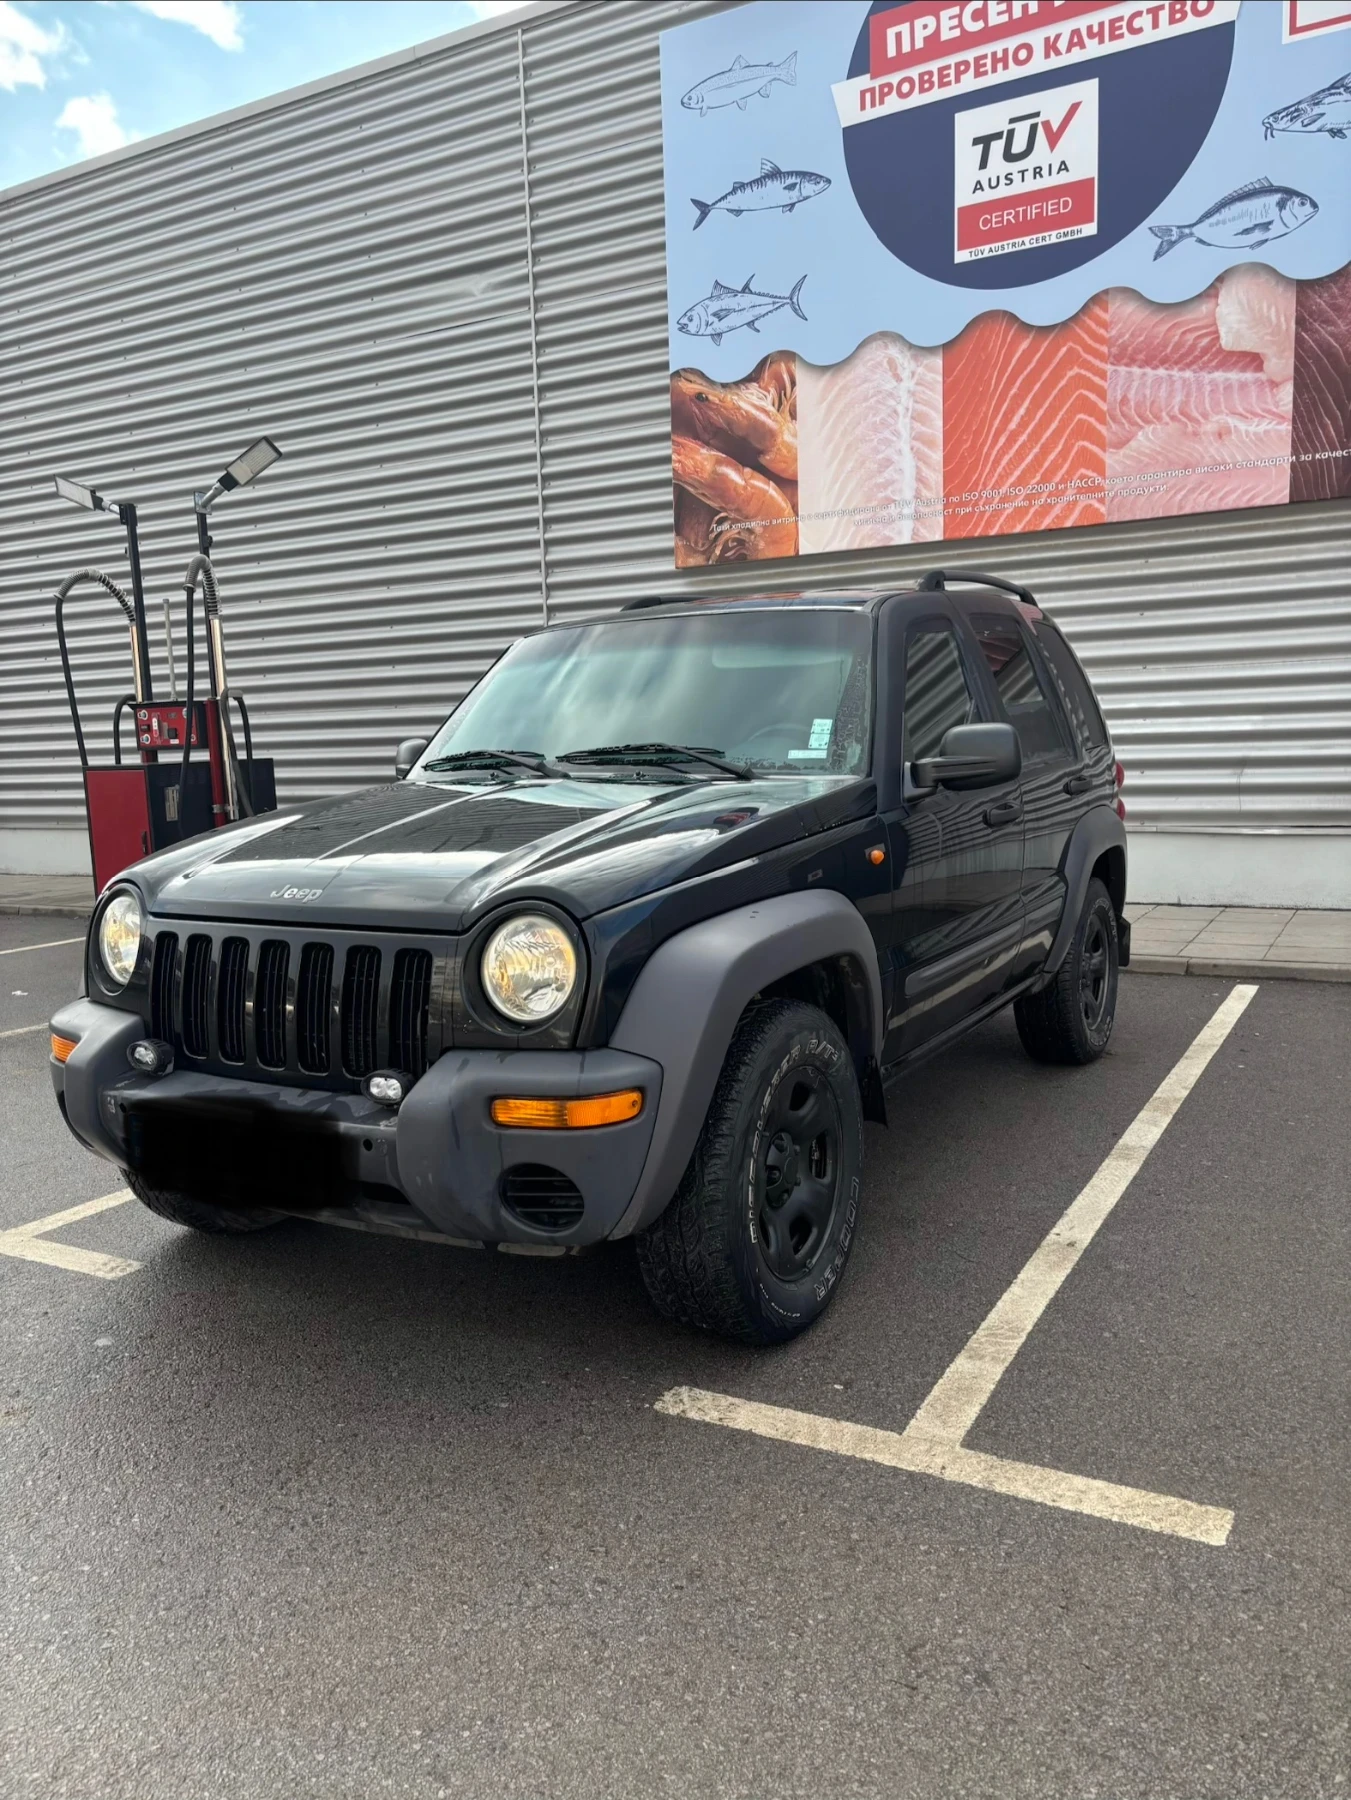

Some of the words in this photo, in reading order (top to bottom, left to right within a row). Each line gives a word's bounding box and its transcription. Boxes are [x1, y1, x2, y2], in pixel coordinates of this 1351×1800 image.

[886, 0, 1039, 58] ПРЕСЕН
[859, 42, 1034, 112] ПРОВЕРЕНО
[1044, 0, 1215, 60] КАЧЕСТВО
[972, 160, 1070, 194] AUSTRIA
[979, 197, 1072, 230] CERTIFIED
[968, 248, 985, 258] TÜV
[988, 240, 1026, 254] AUSTRIA
[1029, 234, 1053, 245] CERT
[1056, 228, 1083, 240] GMBH
[962, 491, 978, 500] ISO
[1007, 486, 1024, 496] ISO
[1026, 482, 1056, 494] 22000
[1058, 483, 1065, 491] и
[1105, 475, 1133, 486] което
[1136, 469, 1192, 481] гарантира
[1195, 463, 1233, 474] високи
[1236, 455, 1296, 469] стандарти
[1299, 453, 1312, 462] за
[955, 506, 972, 516] при
[975, 500, 1029, 513] съхранение
[1032, 498, 1044, 506] на
[1046, 490, 1114, 504] хранителните
[270, 884, 323, 903] Jeep
[816, 1176, 860, 1301] COOPER
